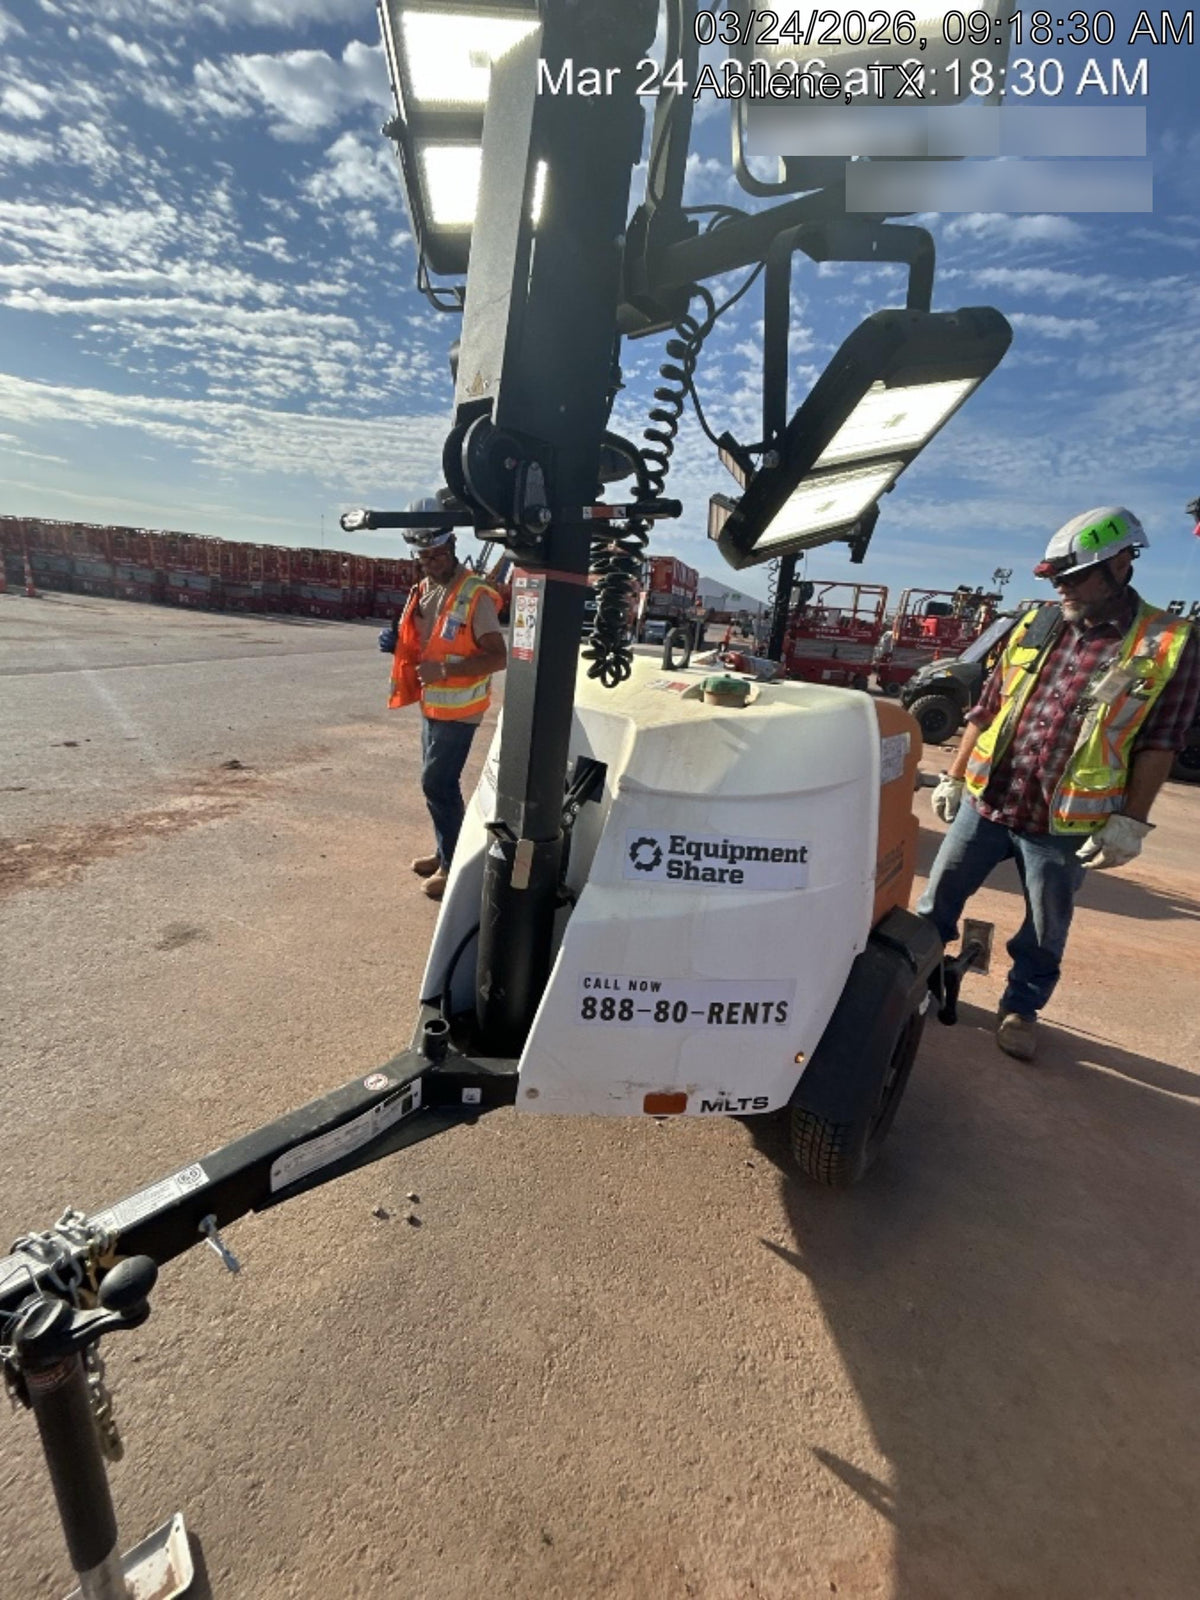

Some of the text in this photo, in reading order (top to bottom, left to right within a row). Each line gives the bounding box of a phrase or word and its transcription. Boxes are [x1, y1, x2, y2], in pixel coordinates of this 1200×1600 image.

[667, 834, 808, 865] Equipment
[666, 859, 744, 884] Share
[583, 977, 662, 993] CALL NOW
[580, 996, 789, 1025] 888-80-RENTS
[700, 1096, 769, 1114] MLTS
